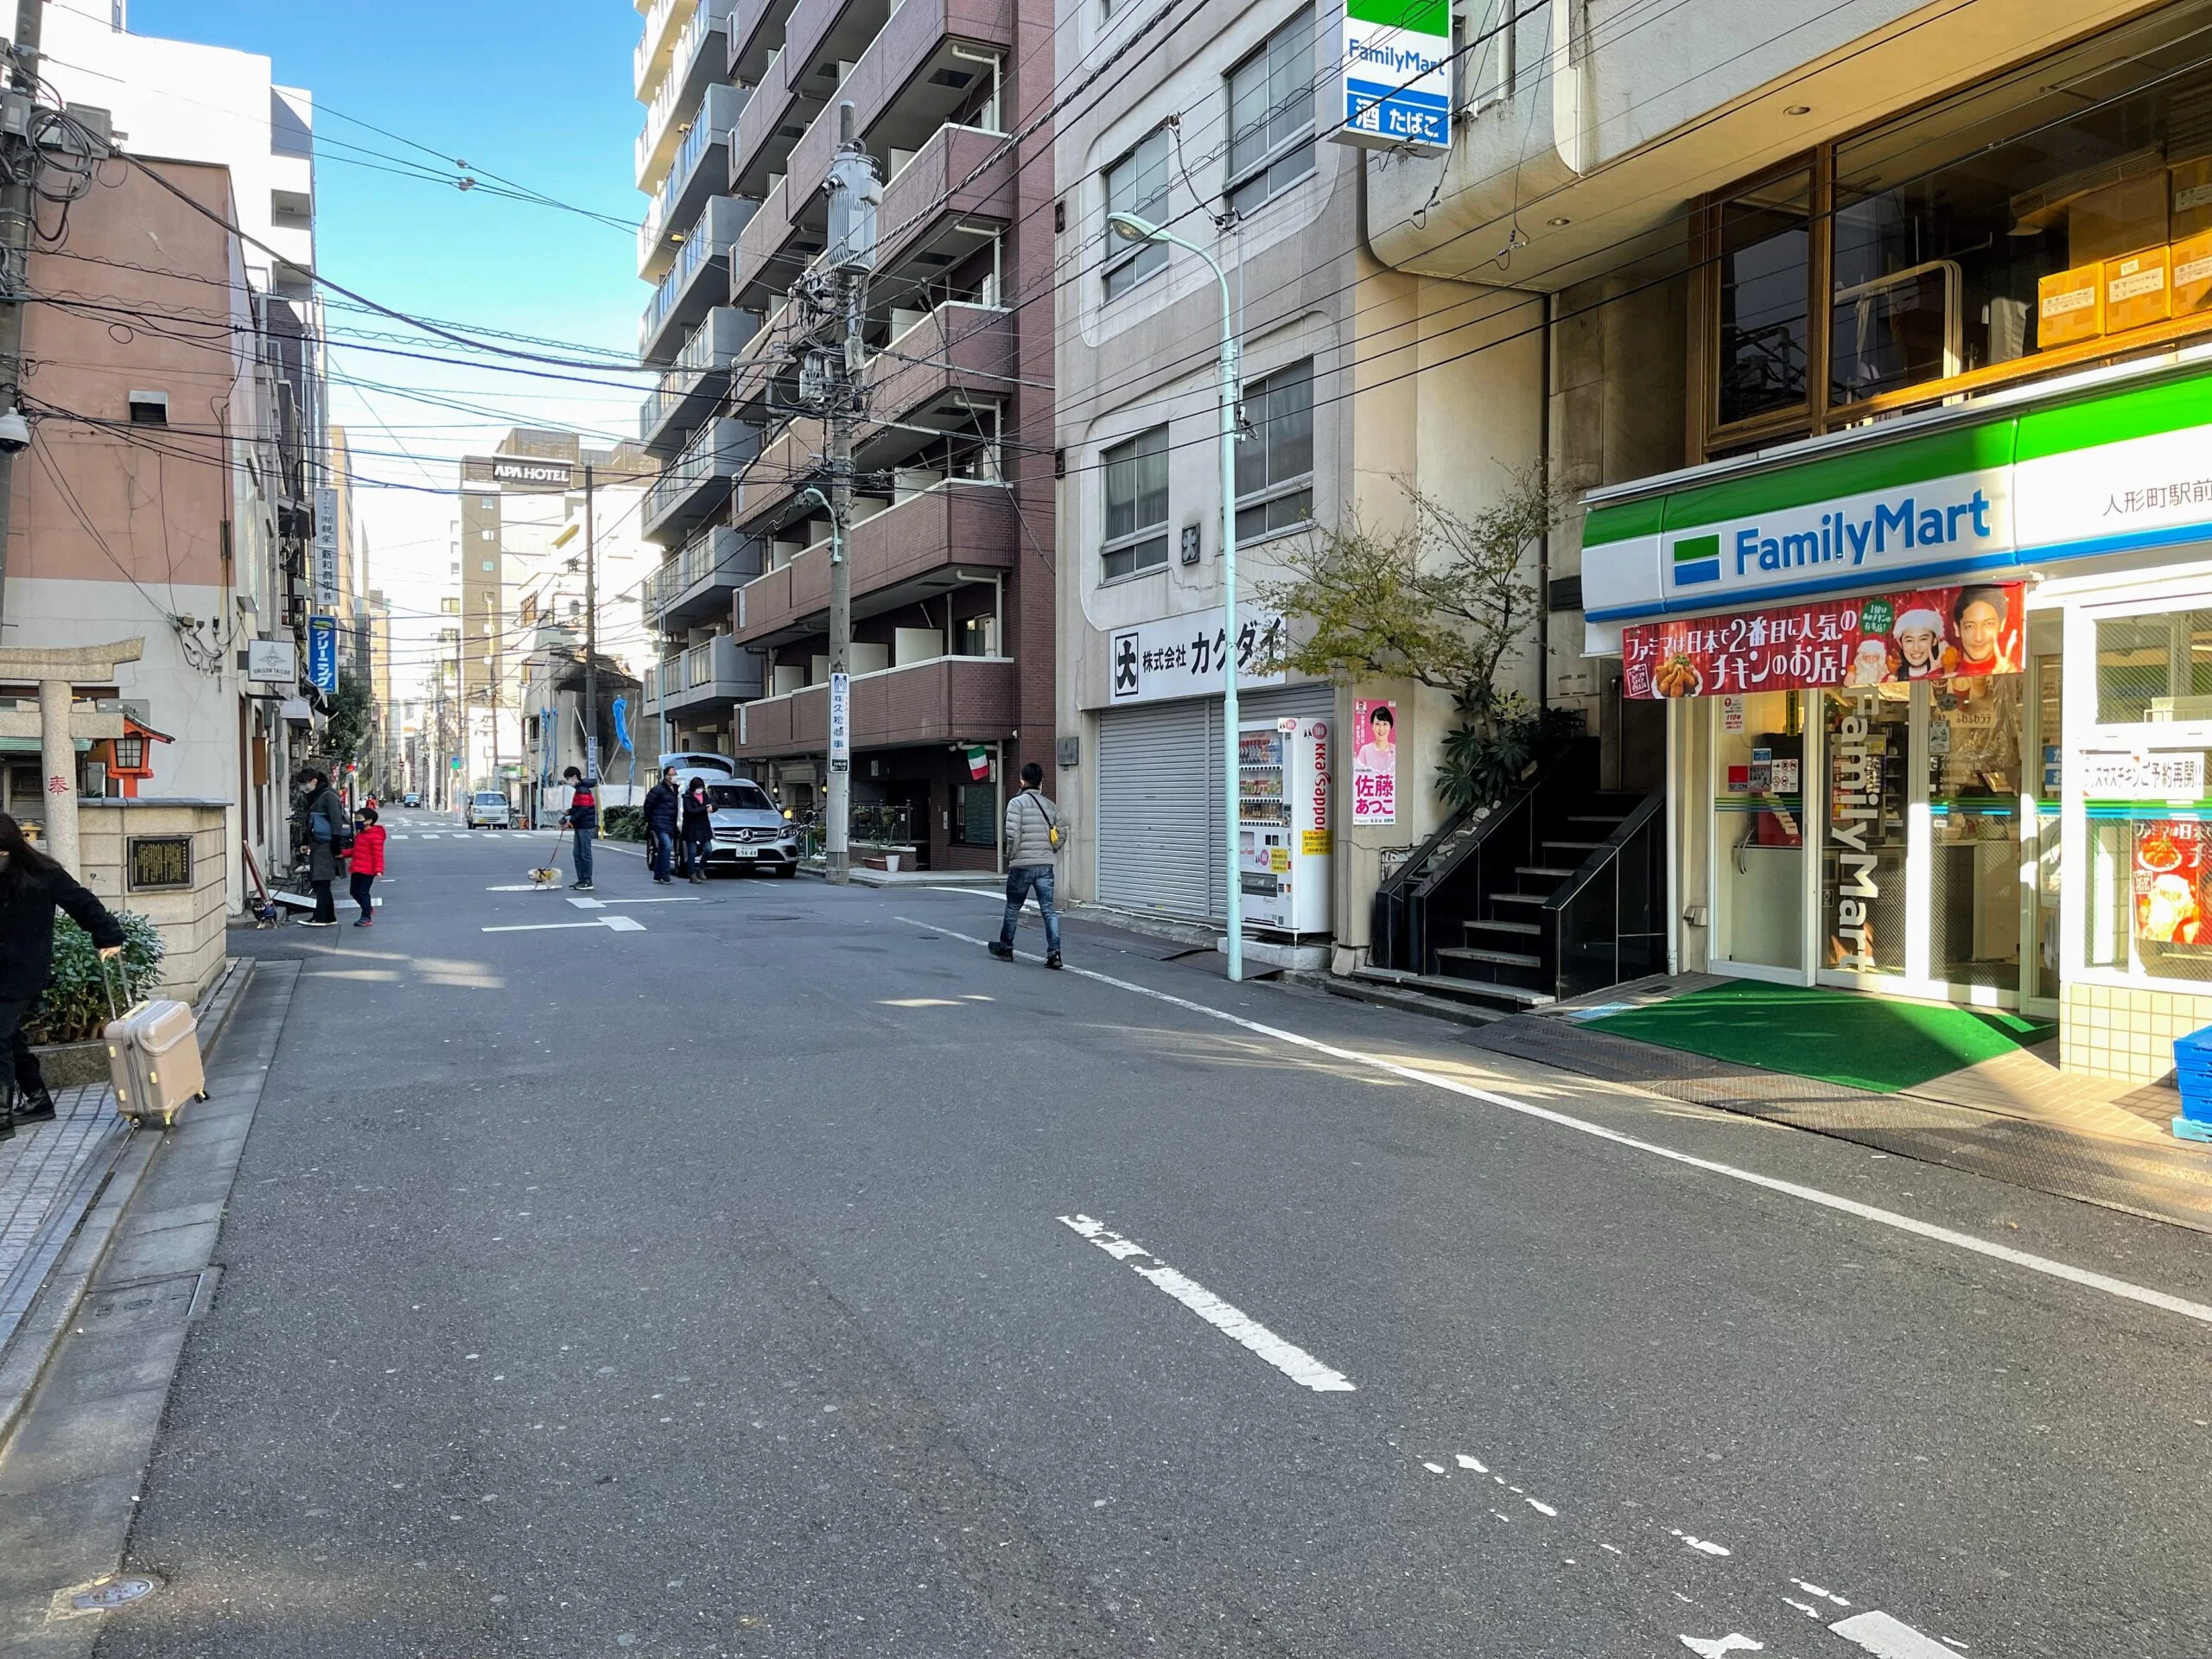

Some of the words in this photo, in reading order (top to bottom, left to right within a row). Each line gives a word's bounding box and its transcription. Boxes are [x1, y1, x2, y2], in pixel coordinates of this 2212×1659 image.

[1349, 38, 1445, 76] FamilyMart
[1355, 98, 1380, 132] 酒
[1389, 108, 1440, 138] たばこ
[494, 465, 522, 478] APA
[524, 467, 569, 482] HOTEL
[2102, 478, 2212, 516] 人形町駅前
[1737, 488, 1991, 575] FamilyMart
[1625, 610, 1858, 661] ファミマは日本で2番目に人気の
[316, 630, 333, 687] クリーニング
[1142, 644, 1187, 673] 株式会社
[1708, 644, 1849, 690] チキンのお店!
[48, 775, 70, 795] 奉
[1355, 774, 1394, 798] 佐藤
[1355, 798, 1394, 815] あつこ
[1832, 688, 1880, 972] FamilyMart
